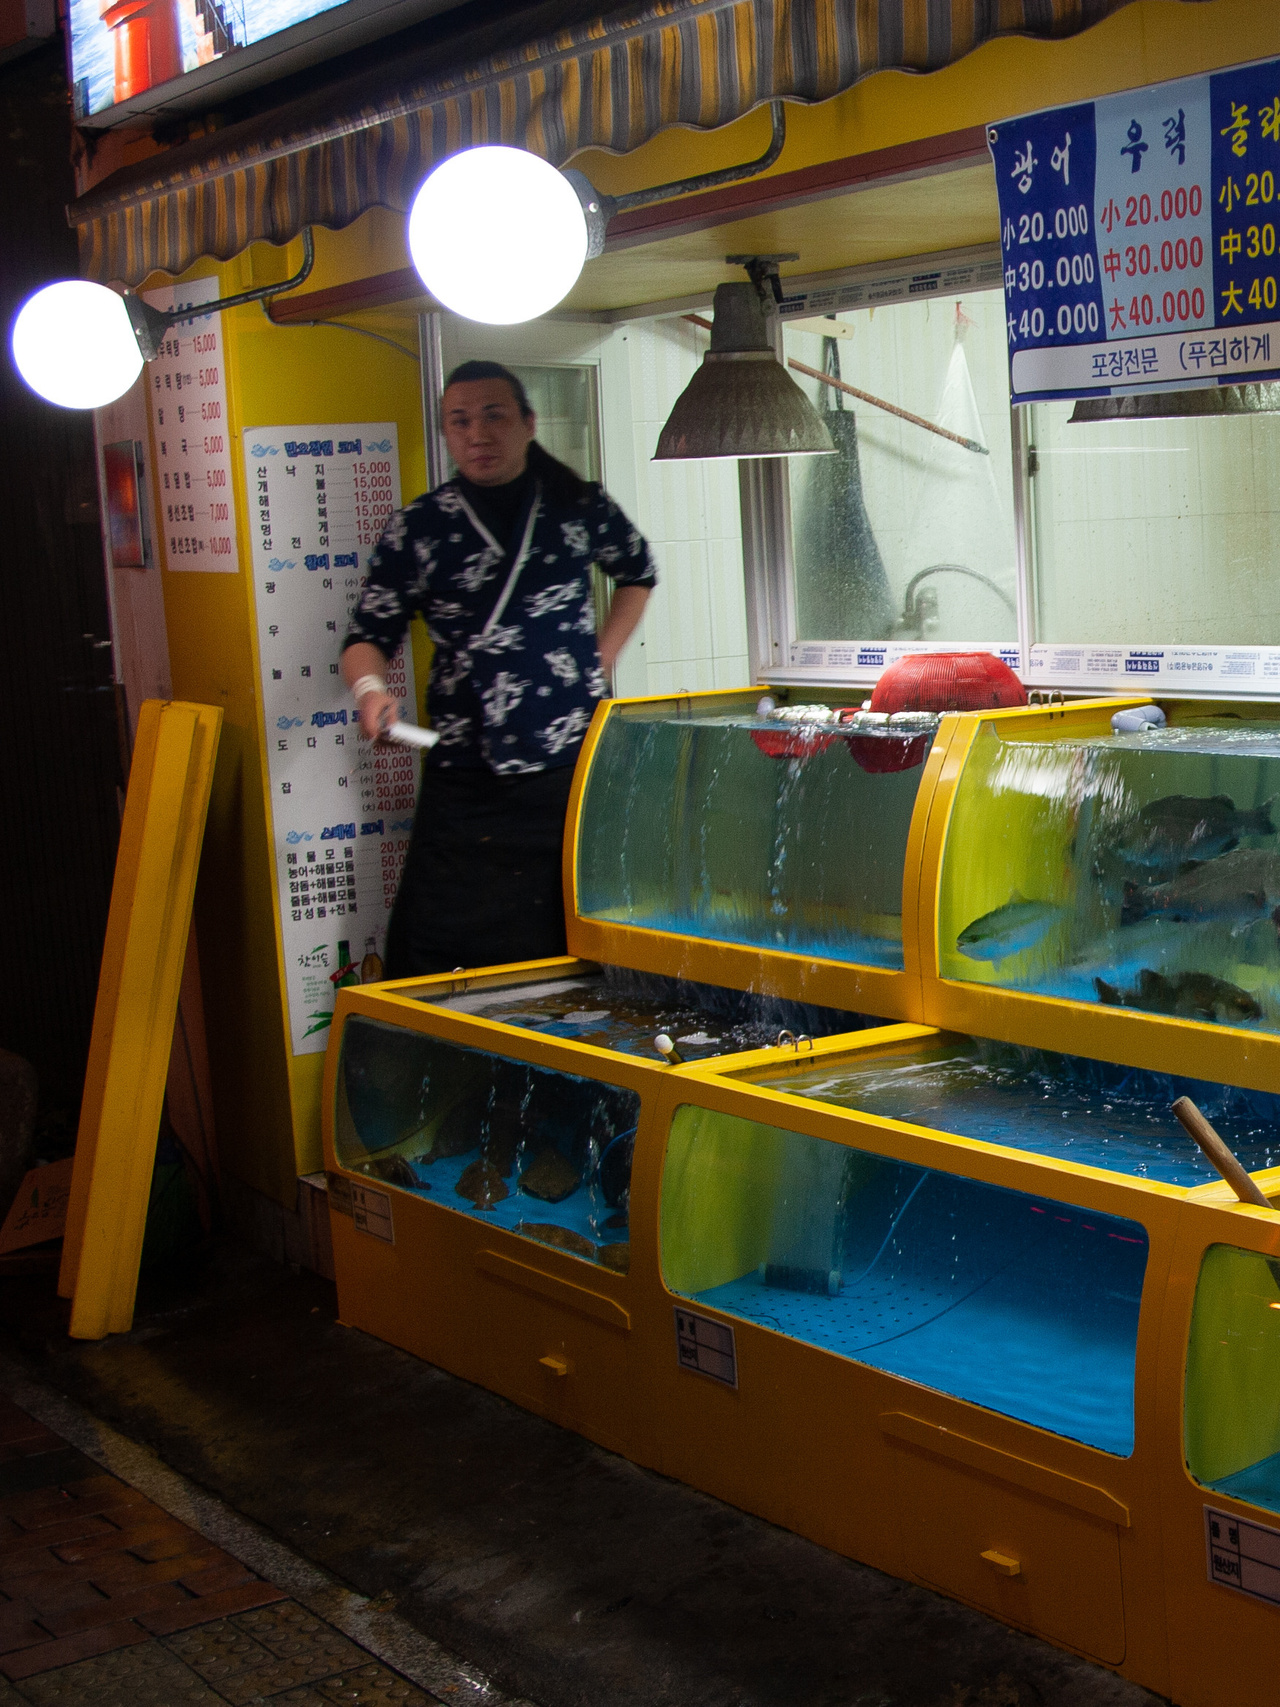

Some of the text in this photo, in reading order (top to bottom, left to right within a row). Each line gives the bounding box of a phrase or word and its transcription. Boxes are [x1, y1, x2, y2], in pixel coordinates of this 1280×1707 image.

[1011, 132, 1071, 193] 광어
[193, 333, 217, 355] 15,000
[1091, 346, 1159, 380] 포장전문
[1178, 334, 1272, 372] (푸짐하게
[199, 367, 219, 389] 5,000
[201, 402, 221, 422] 5,000
[204, 436, 223, 456] 5,000
[352, 462, 391, 476] 15,000
[207, 470, 226, 490] 5,000
[353, 476, 392, 490] 15,000
[354, 490, 393, 504] 15,000
[209, 503, 228, 524] 7,000
[354, 504, 393, 518] 15,000
[209, 537, 231, 557] 10,000
[374, 756, 413, 770] 40,000
[375, 769, 413, 784] 20,000
[376, 783, 414, 798] 30,000
[377, 797, 415, 812] 40,000
